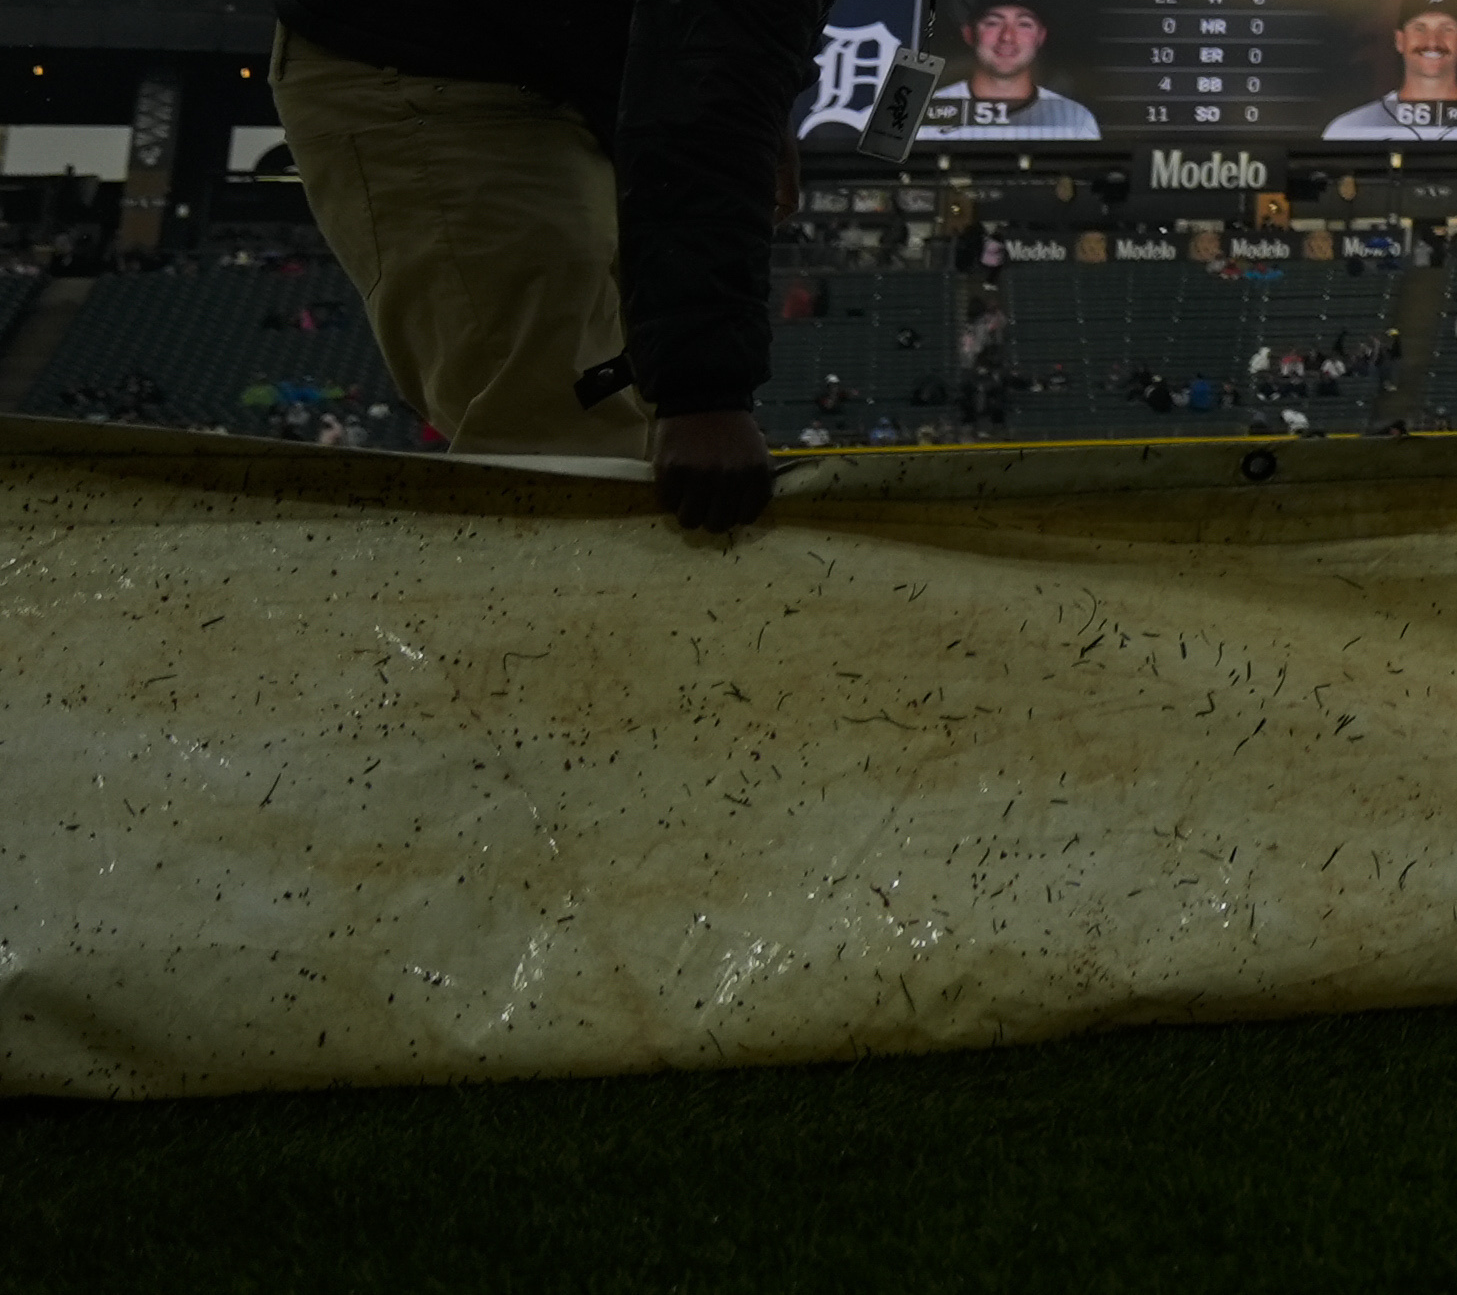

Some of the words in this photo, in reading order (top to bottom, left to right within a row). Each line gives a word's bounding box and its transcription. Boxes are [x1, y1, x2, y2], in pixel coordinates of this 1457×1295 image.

[1157, 76, 1172, 93] 4
[973, 101, 1010, 125] 51
[1397, 103, 1431, 125] 66
[1150, 149, 1268, 189] Modelo
[1116, 238, 1177, 261] Modelo
[1230, 238, 1291, 260] Modelo
